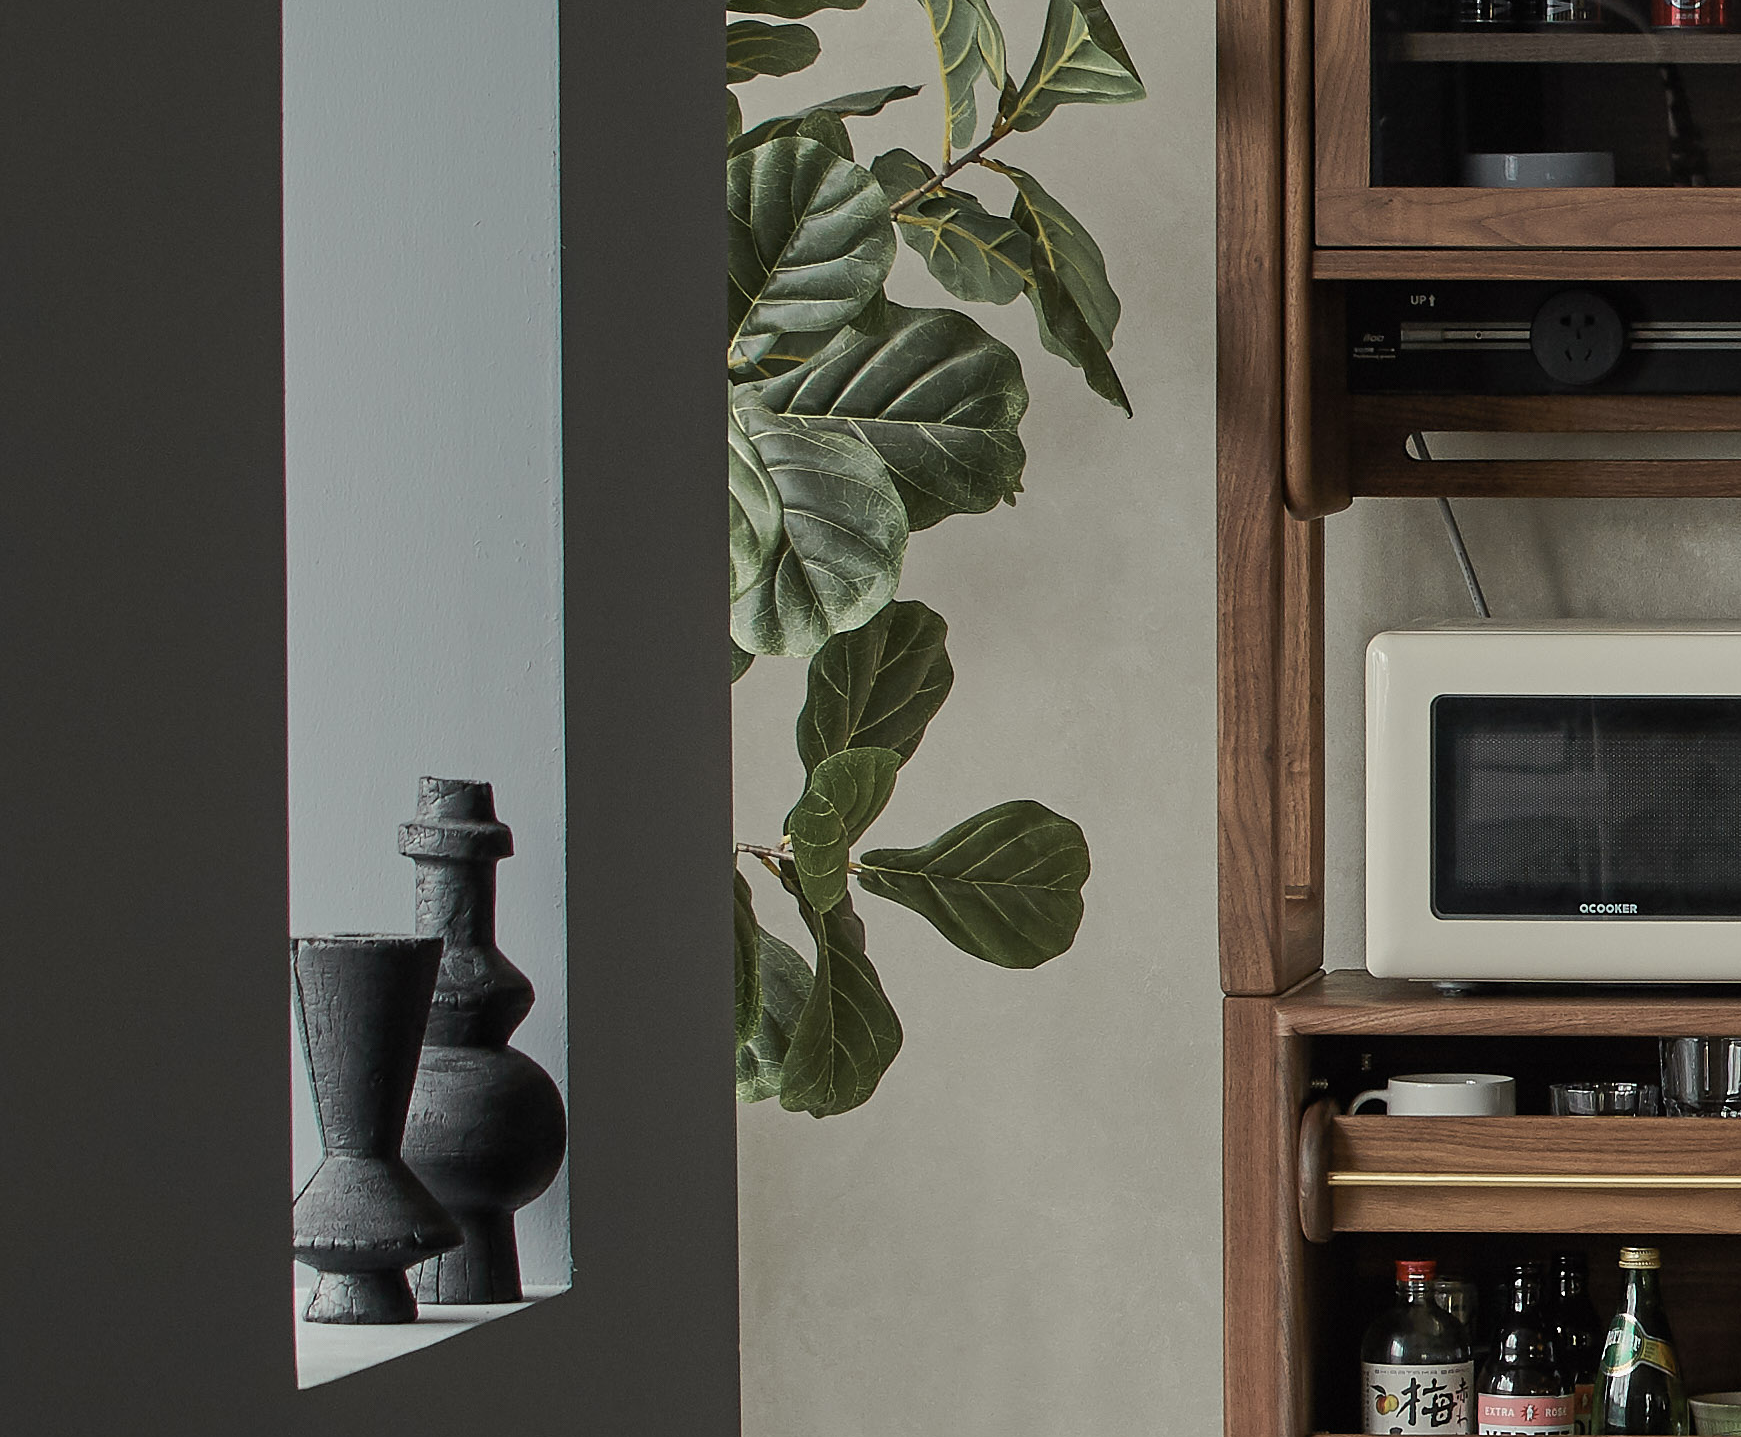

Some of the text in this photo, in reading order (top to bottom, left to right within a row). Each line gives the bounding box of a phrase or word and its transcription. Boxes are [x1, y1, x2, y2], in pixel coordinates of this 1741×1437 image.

[1410, 294, 1428, 306] UP
[1579, 903, 1639, 915] QCOOKER
[1484, 1405, 1515, 1418] EXTRA
